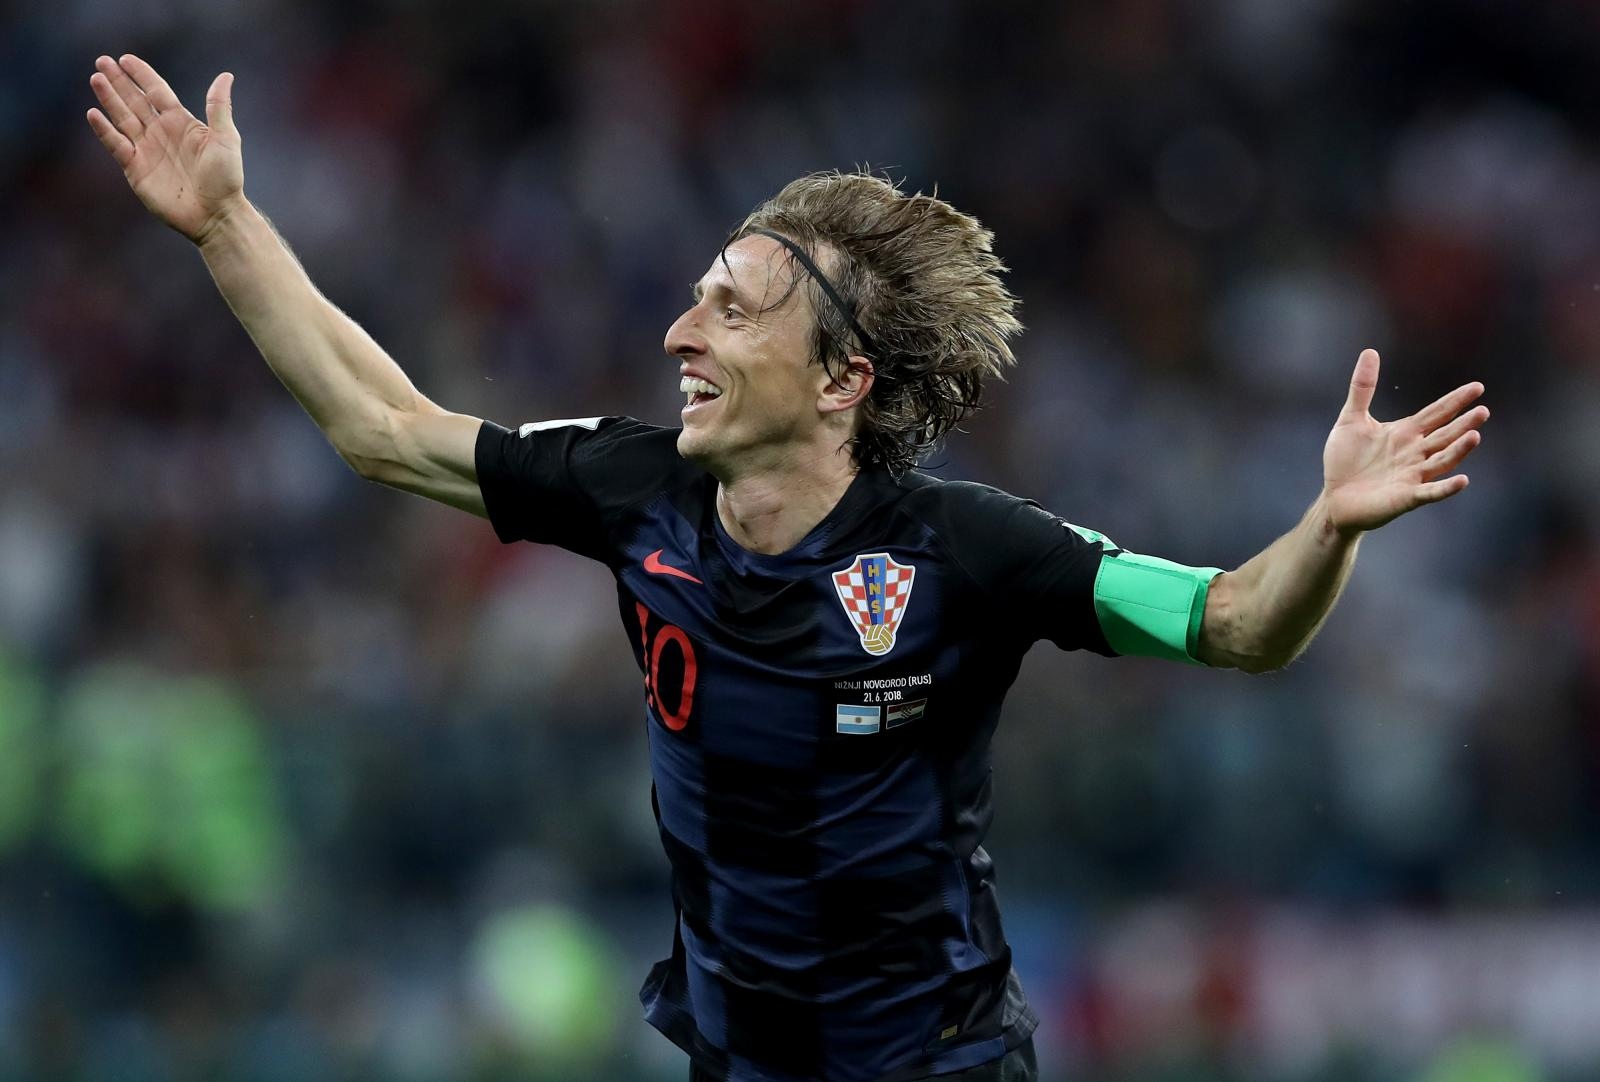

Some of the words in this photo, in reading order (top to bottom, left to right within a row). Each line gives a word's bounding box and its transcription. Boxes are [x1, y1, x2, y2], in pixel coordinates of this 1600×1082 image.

[867, 565, 881, 614] HNS
[863, 678, 907, 689] NOVGOROD
[908, 673, 932, 687] (RUS)
[883, 690, 904, 702] 2018.
